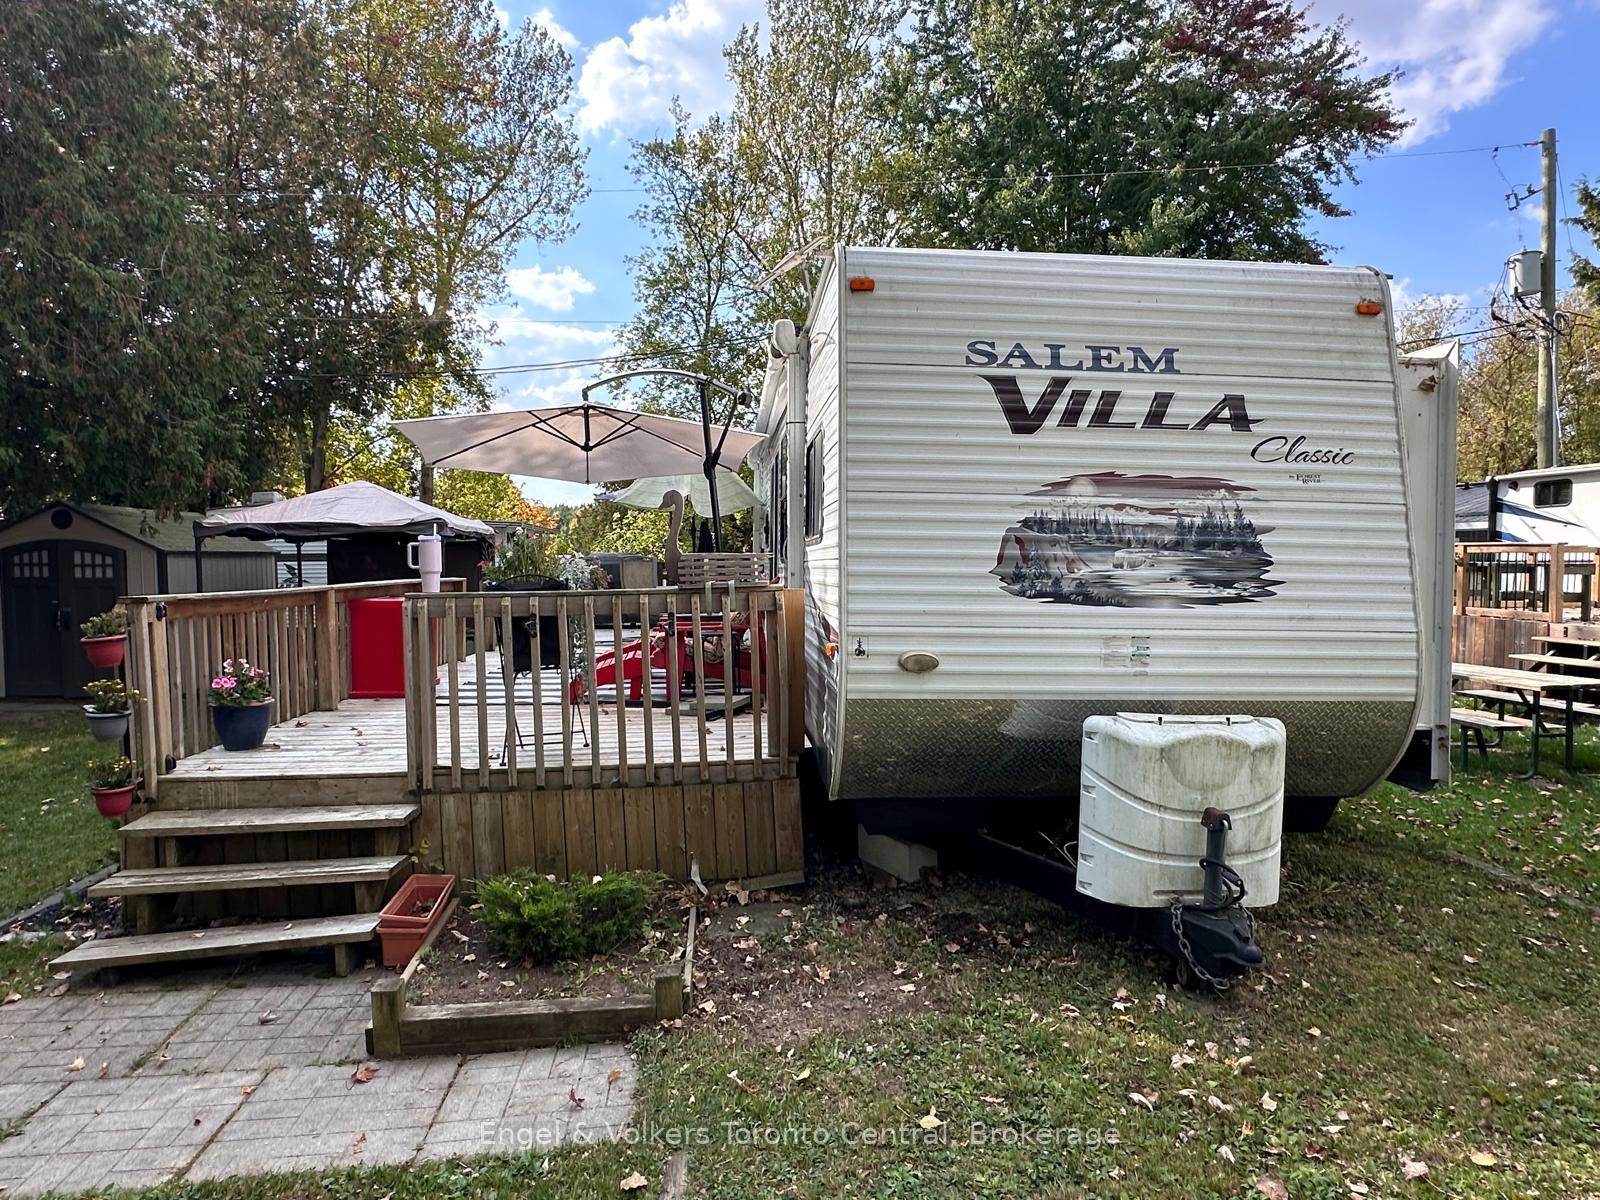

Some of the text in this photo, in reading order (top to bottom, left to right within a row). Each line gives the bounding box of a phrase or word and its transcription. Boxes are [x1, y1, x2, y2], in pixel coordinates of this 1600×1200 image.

[965, 340, 1181, 372] SALEM
[977, 374, 1267, 435] VILLA
[1250, 435, 1355, 465] Classic
